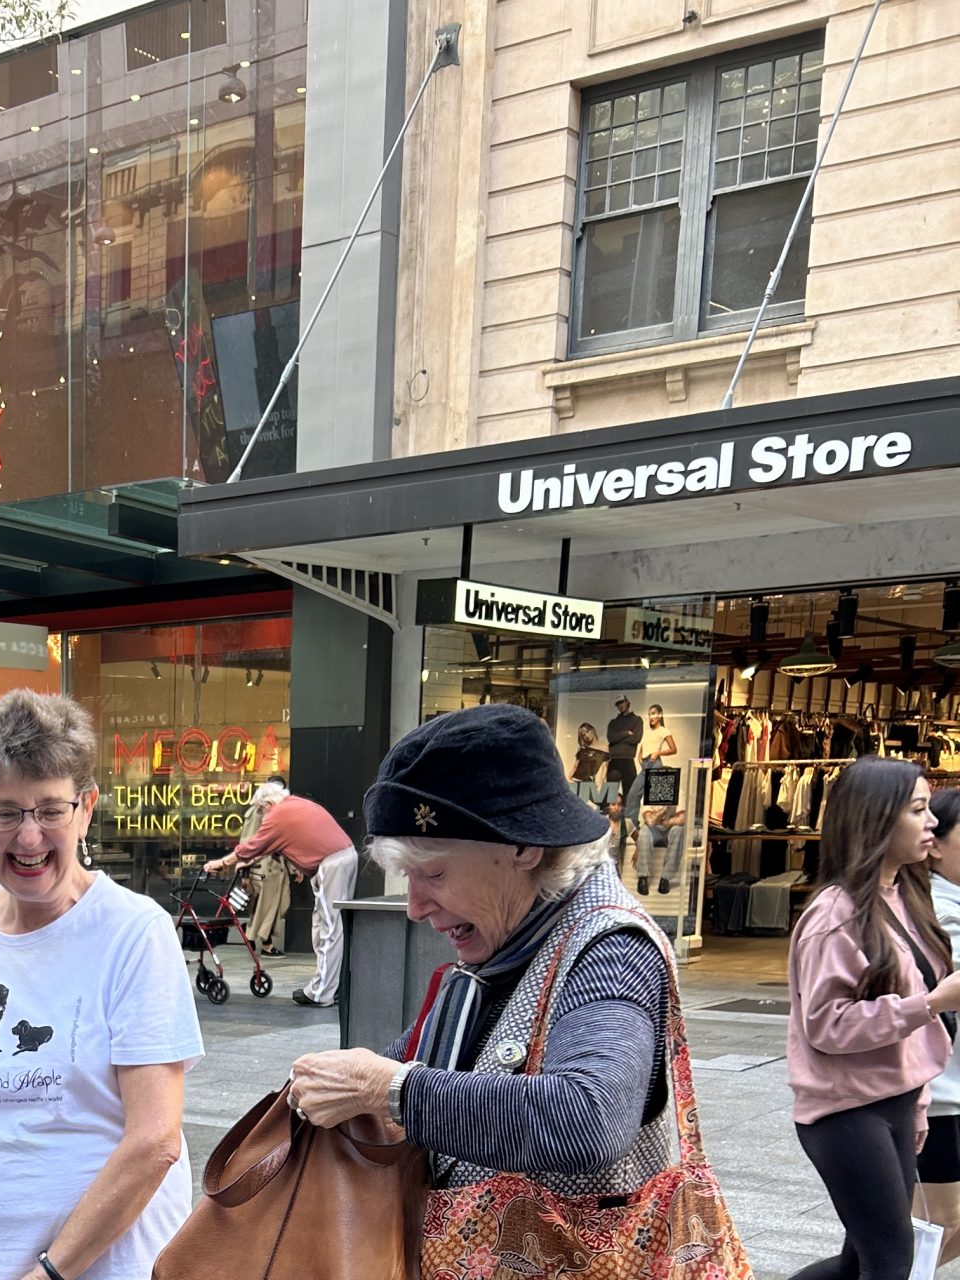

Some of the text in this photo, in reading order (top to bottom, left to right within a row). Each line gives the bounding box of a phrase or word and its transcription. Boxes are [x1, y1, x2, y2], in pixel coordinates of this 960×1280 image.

[497, 431, 913, 515] Universal Store
[464, 588, 596, 634] Universal Store
[114, 725, 285, 776] MECCA
[113, 784, 181, 808] THINK
[113, 813, 244, 837] THINK MEC
[9, 1067, 62, 1094] Maple
